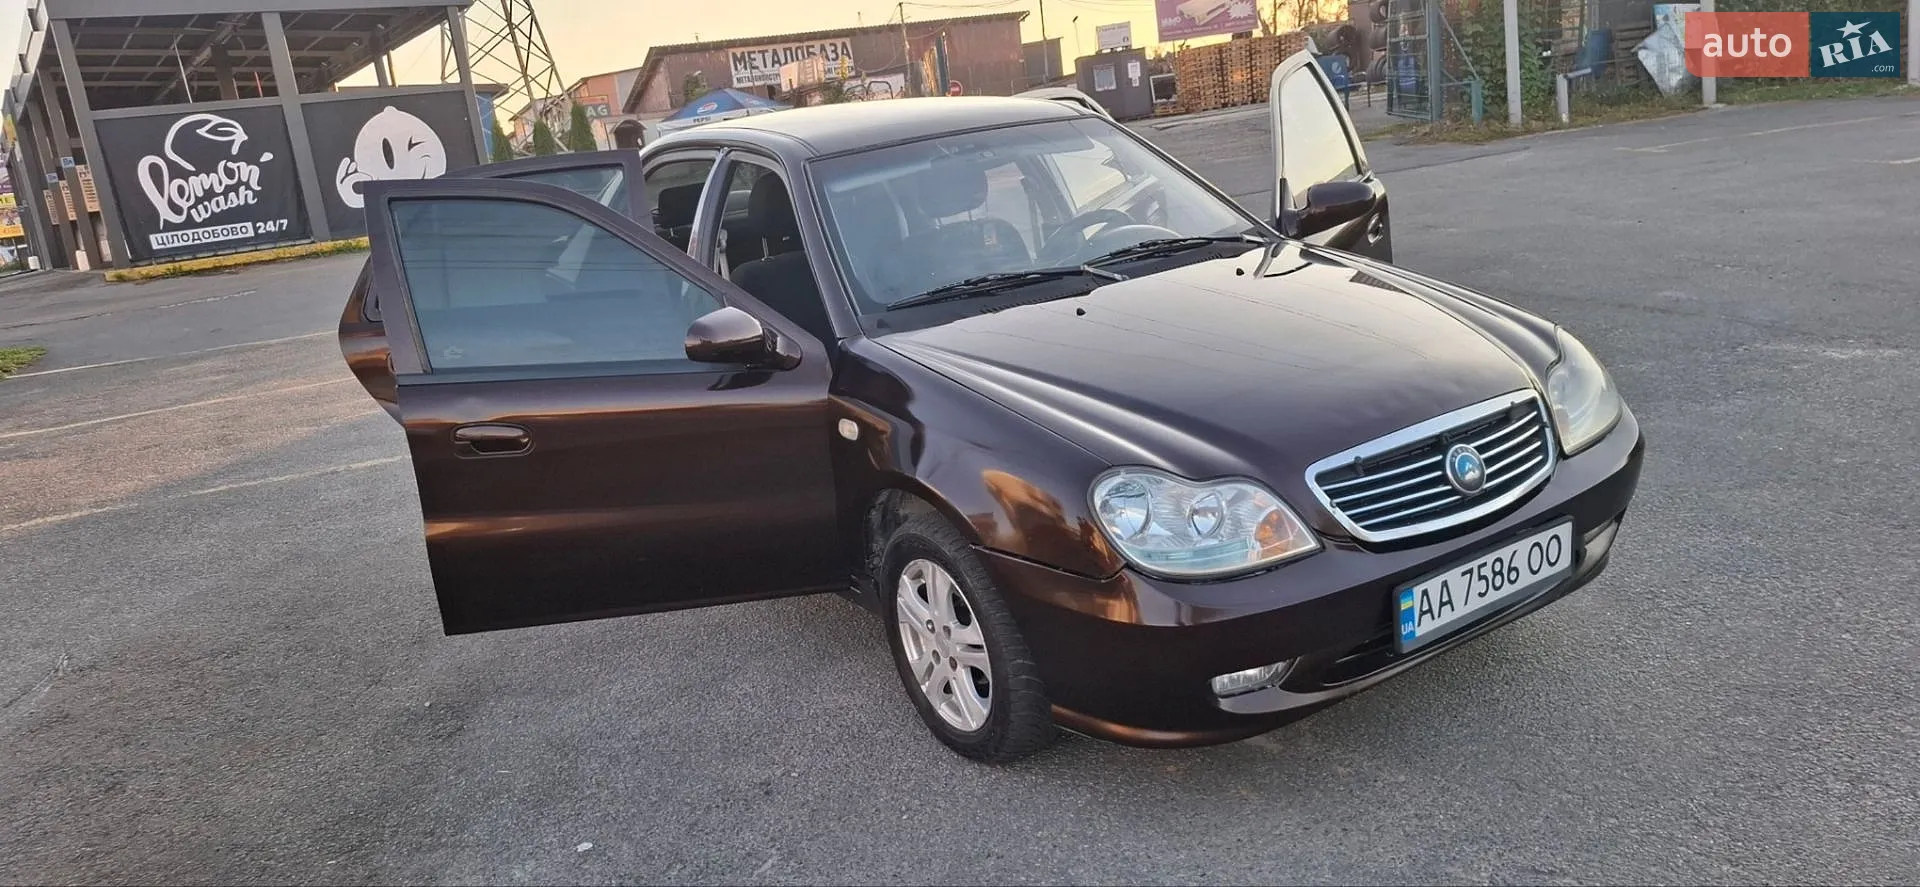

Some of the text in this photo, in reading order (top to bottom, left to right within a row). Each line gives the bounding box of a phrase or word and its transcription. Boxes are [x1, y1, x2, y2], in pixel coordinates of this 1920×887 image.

[190, 185, 257, 223] wash
[155, 219, 288, 247] ЦІЛОДОБОВО 24/7
[1417, 579, 1455, 627] AA
[1461, 549, 1520, 606] 7586
[1401, 621, 1414, 635] UA
